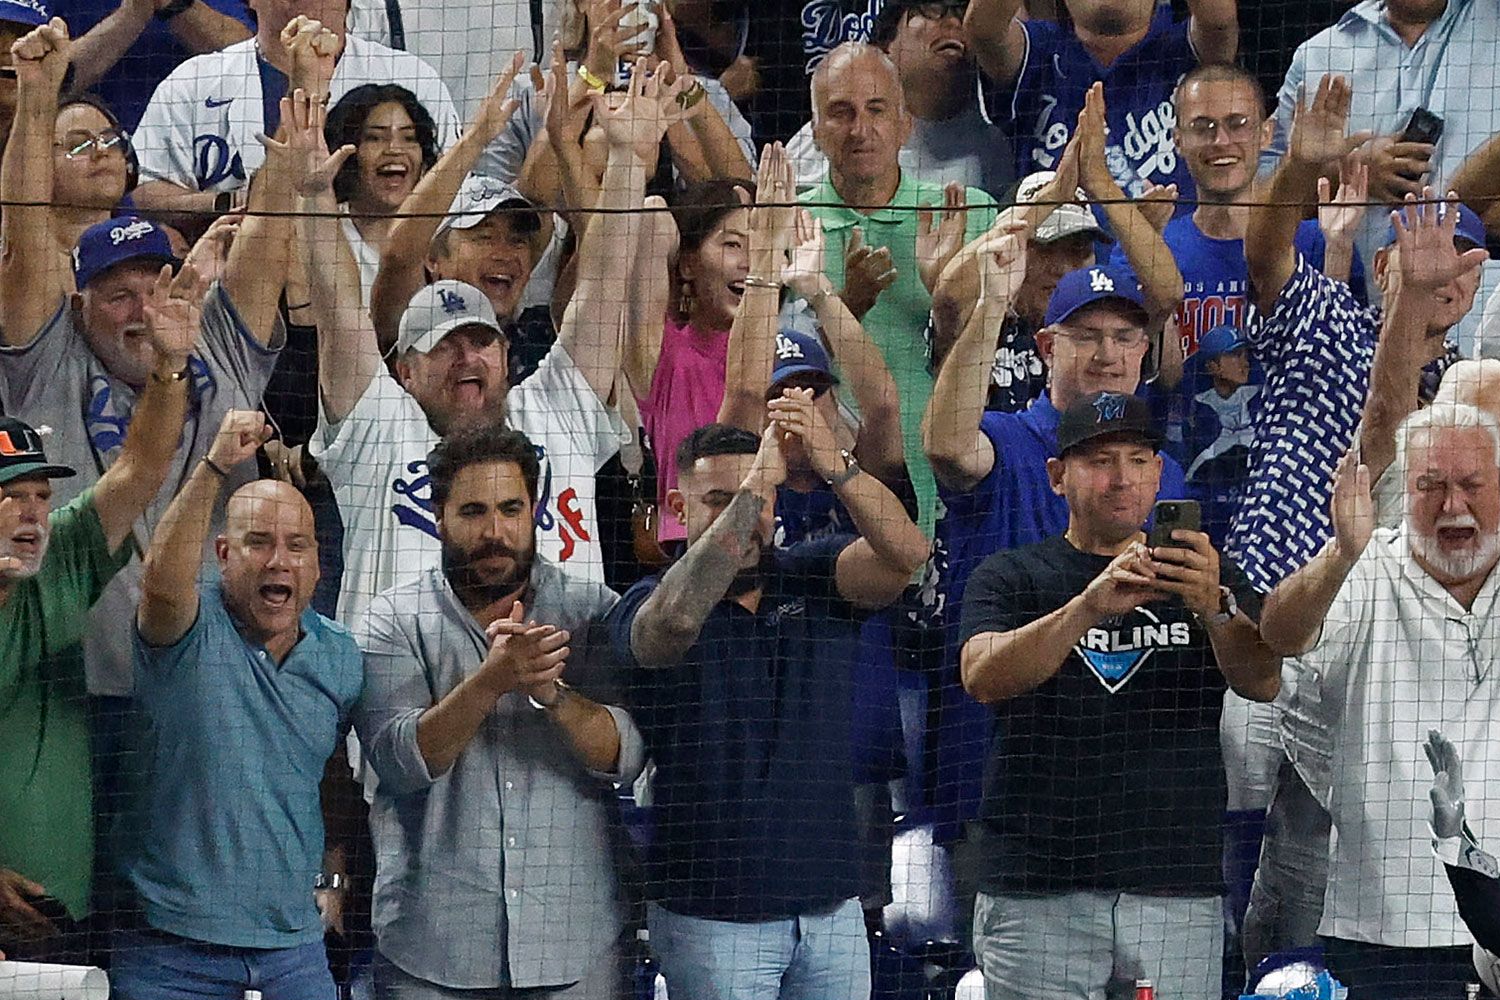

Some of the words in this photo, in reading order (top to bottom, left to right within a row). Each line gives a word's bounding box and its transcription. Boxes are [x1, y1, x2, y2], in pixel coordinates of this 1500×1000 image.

[1088, 268, 1115, 292] LA
[775, 332, 805, 360] LA
[1080, 622, 1191, 653] RLINS
